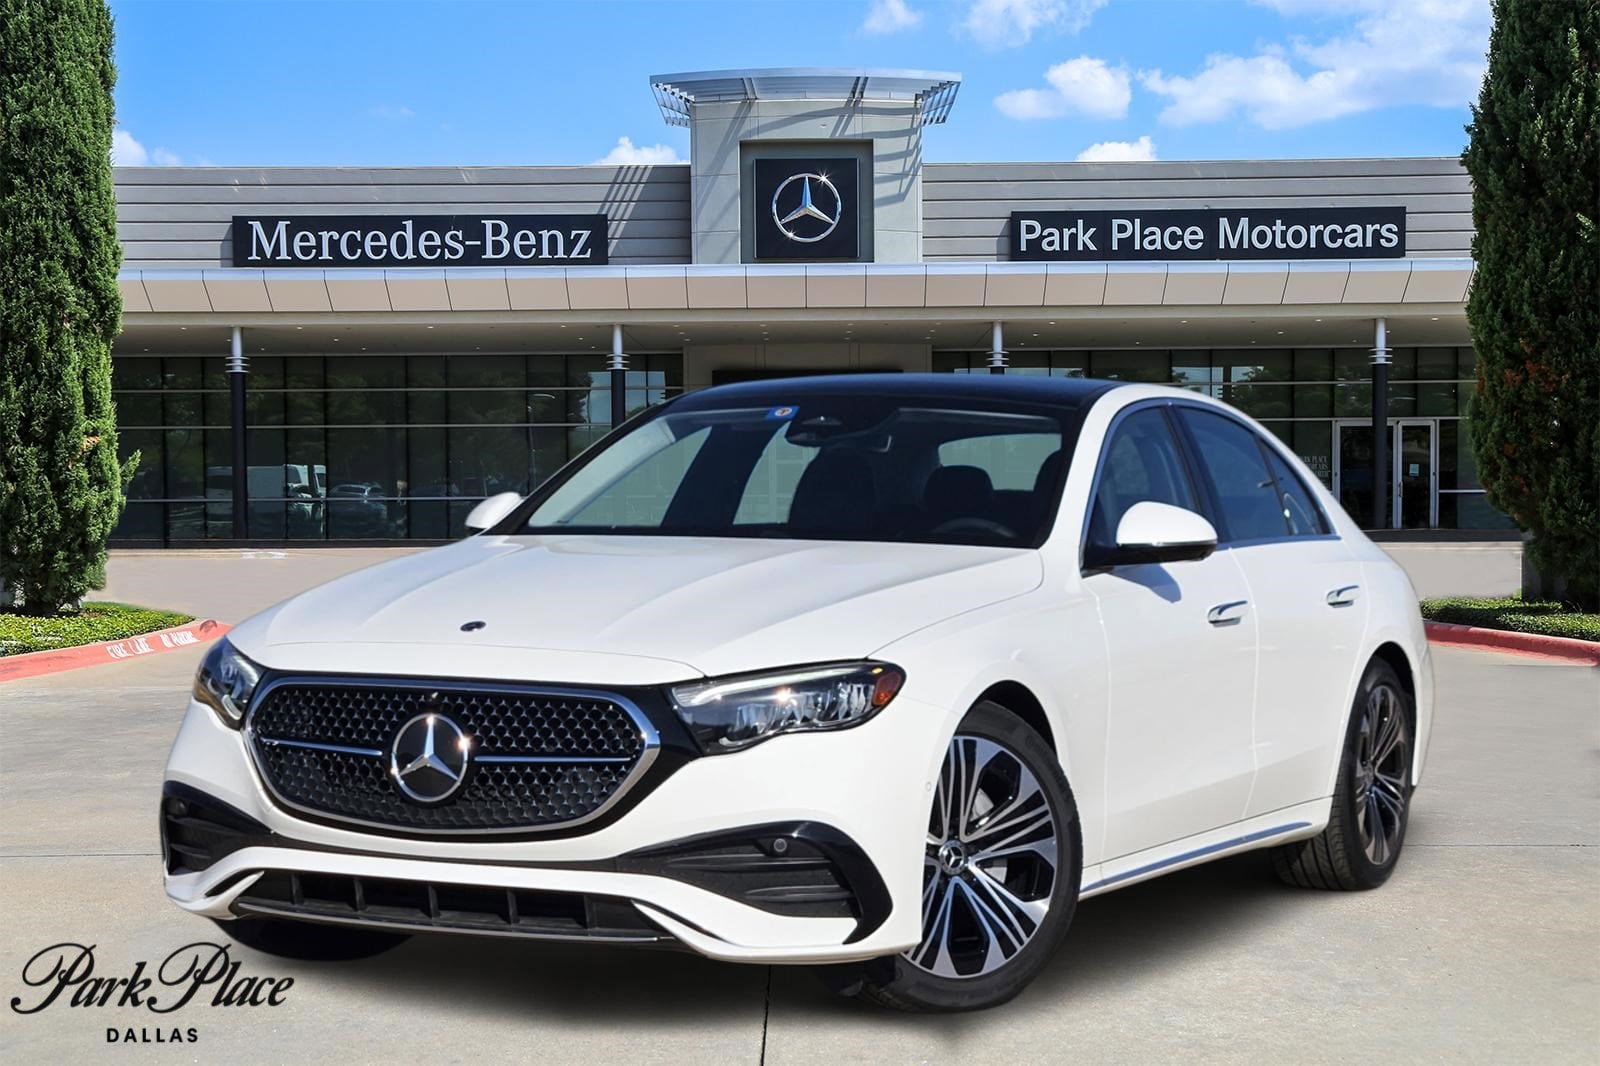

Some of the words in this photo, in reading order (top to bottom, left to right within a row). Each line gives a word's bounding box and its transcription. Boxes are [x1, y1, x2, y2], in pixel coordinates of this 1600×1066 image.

[247, 219, 592, 260] Mercedes-Benz
[1020, 219, 1098, 252] Park
[1111, 218, 1204, 251] Place
[1218, 217, 1399, 249] Motorcars
